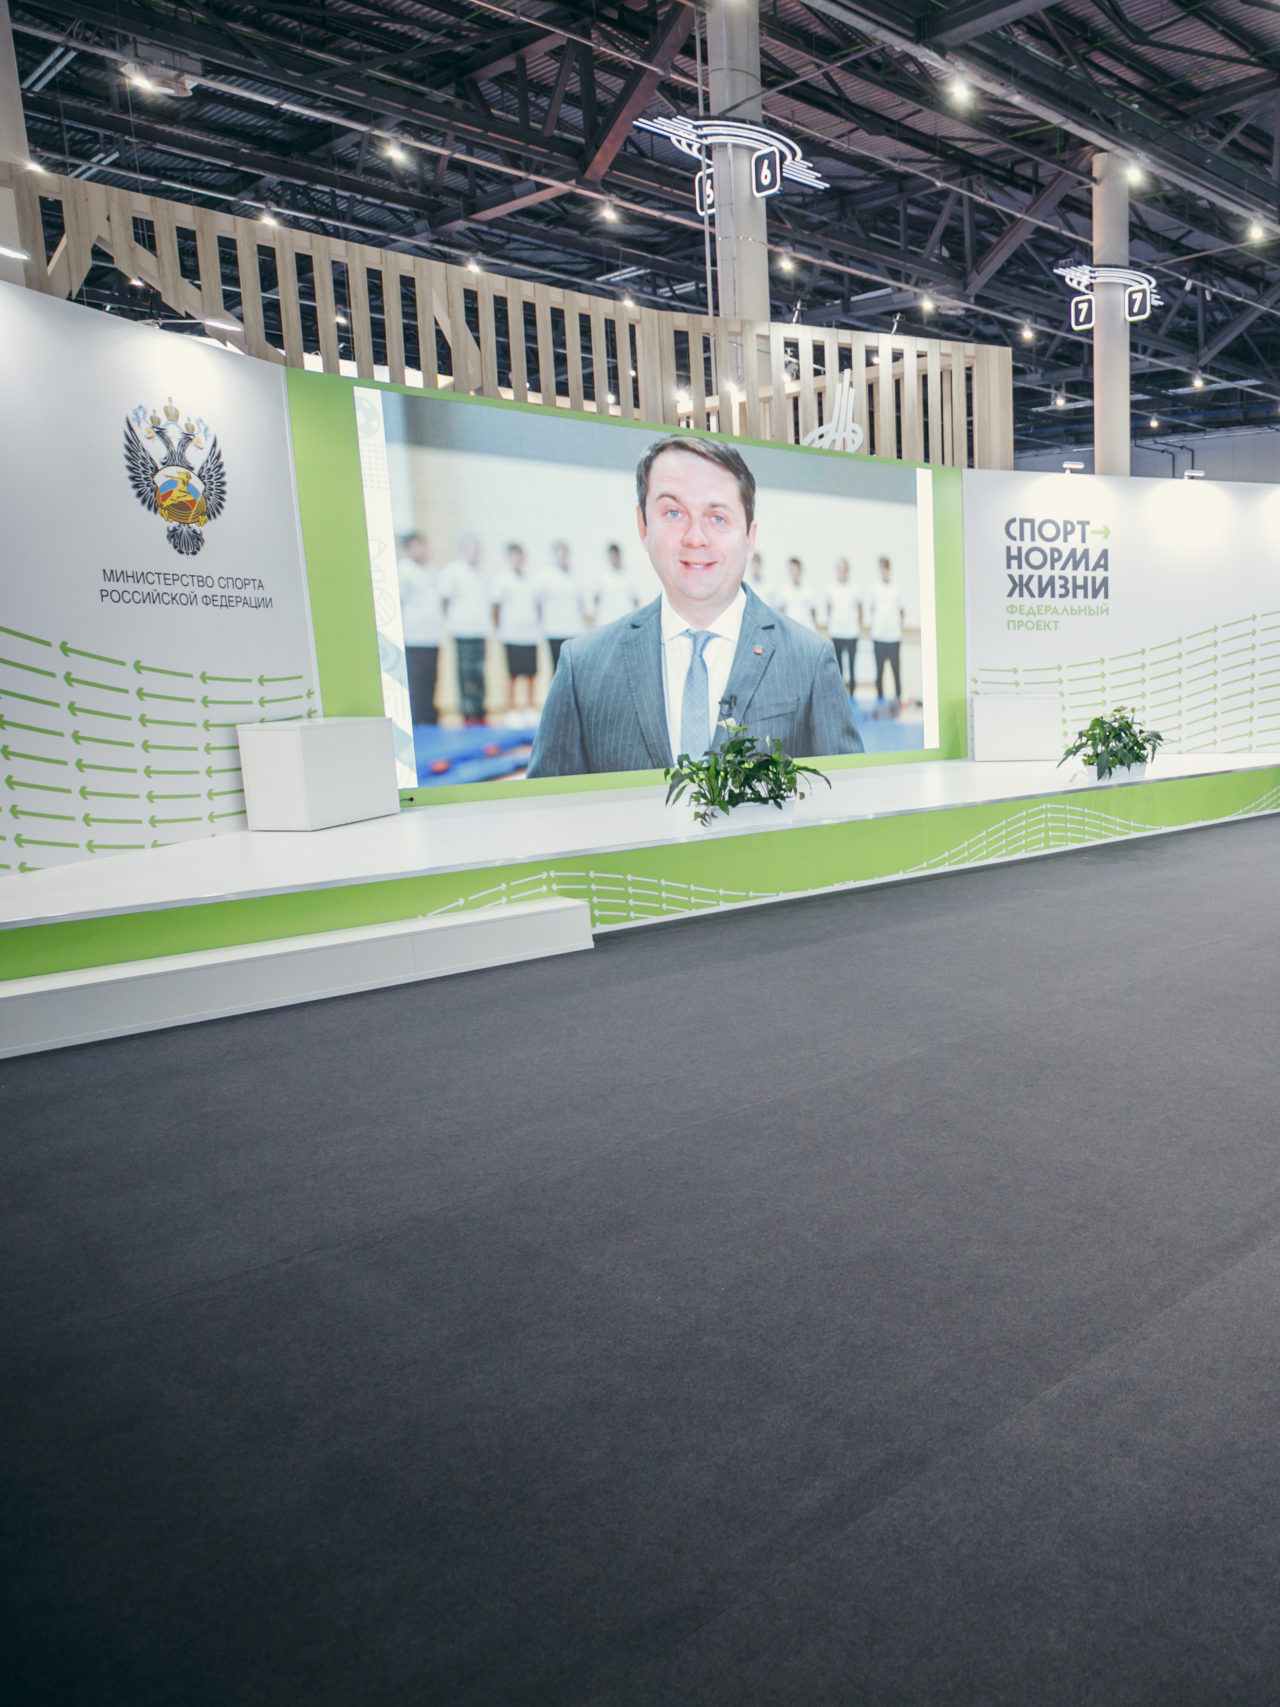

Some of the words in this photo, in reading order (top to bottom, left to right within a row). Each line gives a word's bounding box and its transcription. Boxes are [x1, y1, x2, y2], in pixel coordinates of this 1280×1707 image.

[760, 159, 772, 186] 6
[704, 179, 715, 205] 6
[1077, 301, 1089, 323] 7
[1131, 291, 1144, 314] 7
[1004, 517, 1091, 543] СПОРТ
[1005, 545, 1109, 572] НОРМА
[102, 568, 215, 588] МИНИСТЕРСТВО
[217, 576, 265, 591] СПОРТА
[1006, 574, 1109, 600] ЖИЗНИ
[100, 588, 199, 607] РОССИЙСКОЙ
[201, 594, 273, 610] ФЕДЕРАЦИИ
[1005, 602, 1110, 617] ФЕДЕРАЛЬНЫЙ
[1007, 619, 1060, 632] ПРОЕКТ
